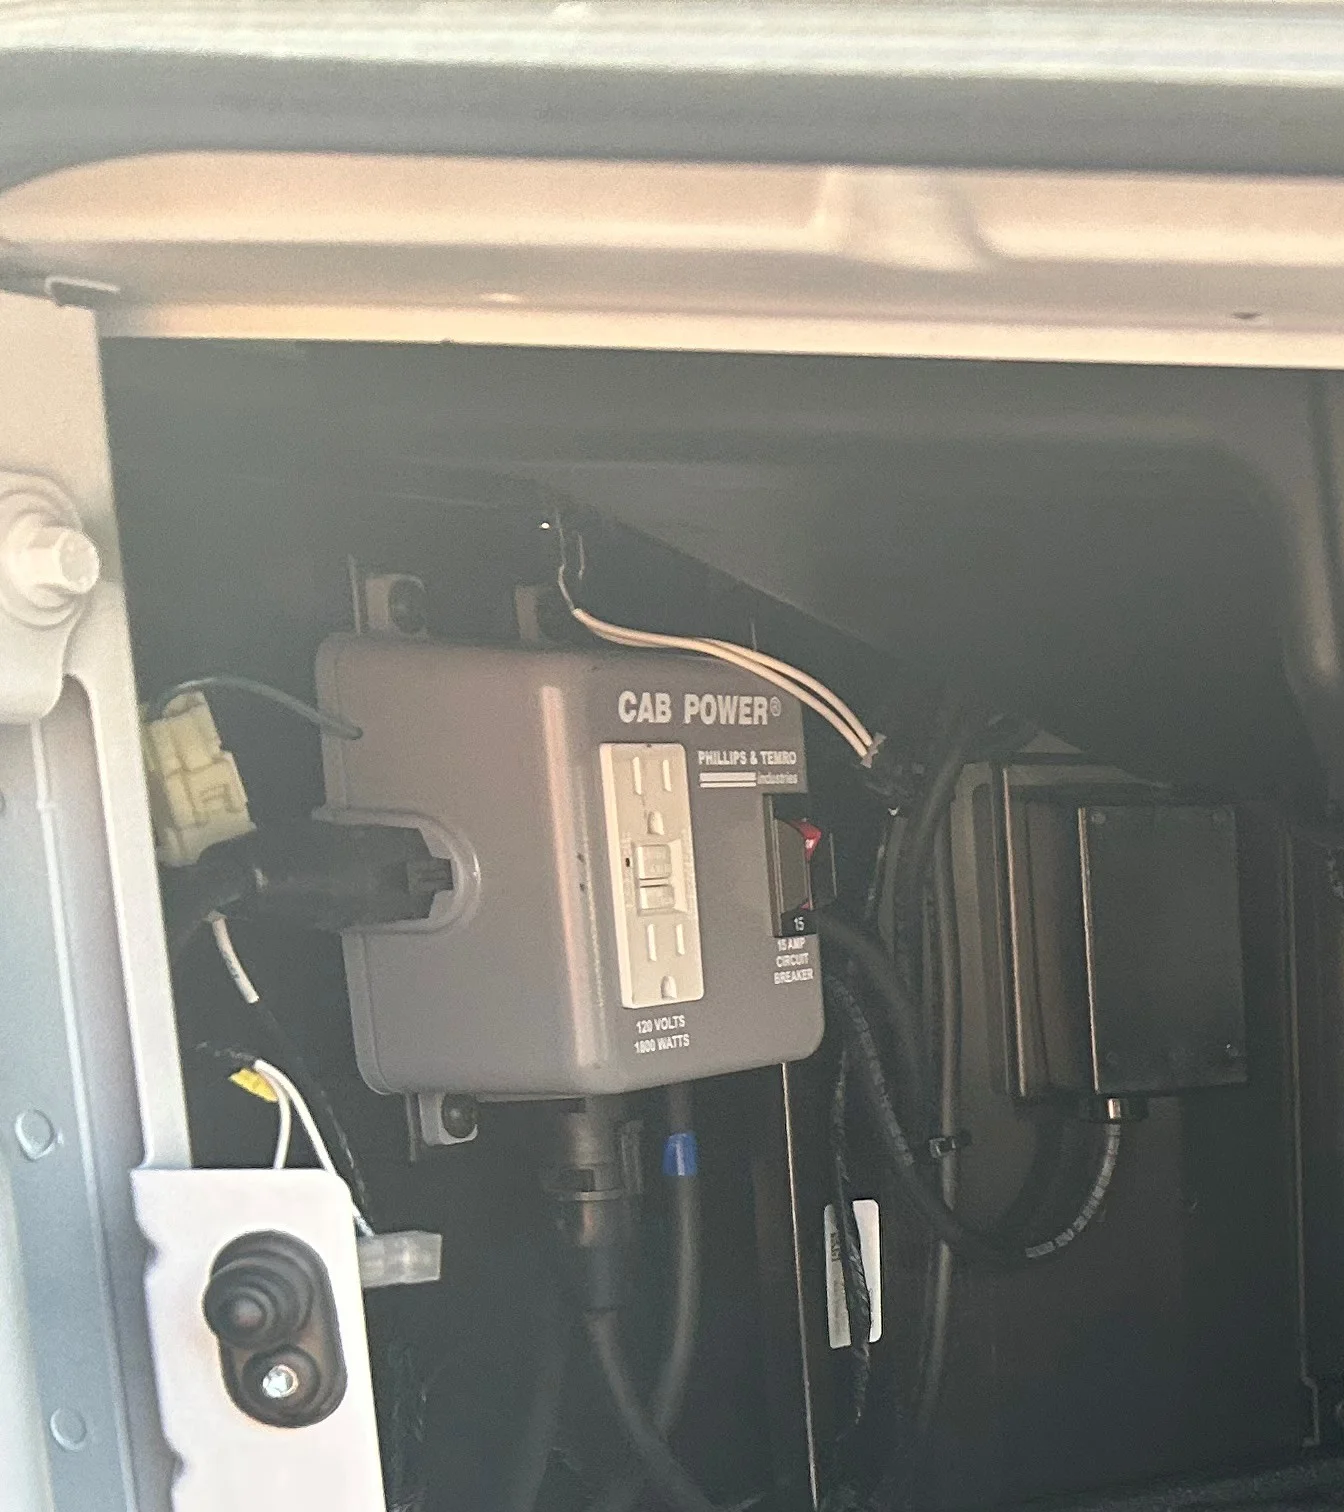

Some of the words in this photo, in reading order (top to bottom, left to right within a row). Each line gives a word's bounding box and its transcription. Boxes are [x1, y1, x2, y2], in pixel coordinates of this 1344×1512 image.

[618, 690, 671, 724] CAB
[698, 750, 747, 765] PHILLIPS
[750, 750, 758, 765] &
[760, 750, 797, 765] TEMRO
[794, 916, 805, 931] 15
[778, 938, 787, 951] 15
[788, 937, 806, 950] AMP
[776, 952, 809, 967] CIRCUIT
[773, 968, 814, 984] BREAKER
[636, 1019, 653, 1033] 120
[653, 1014, 686, 1031] VOLTS
[656, 1033, 690, 1050] WATTS
